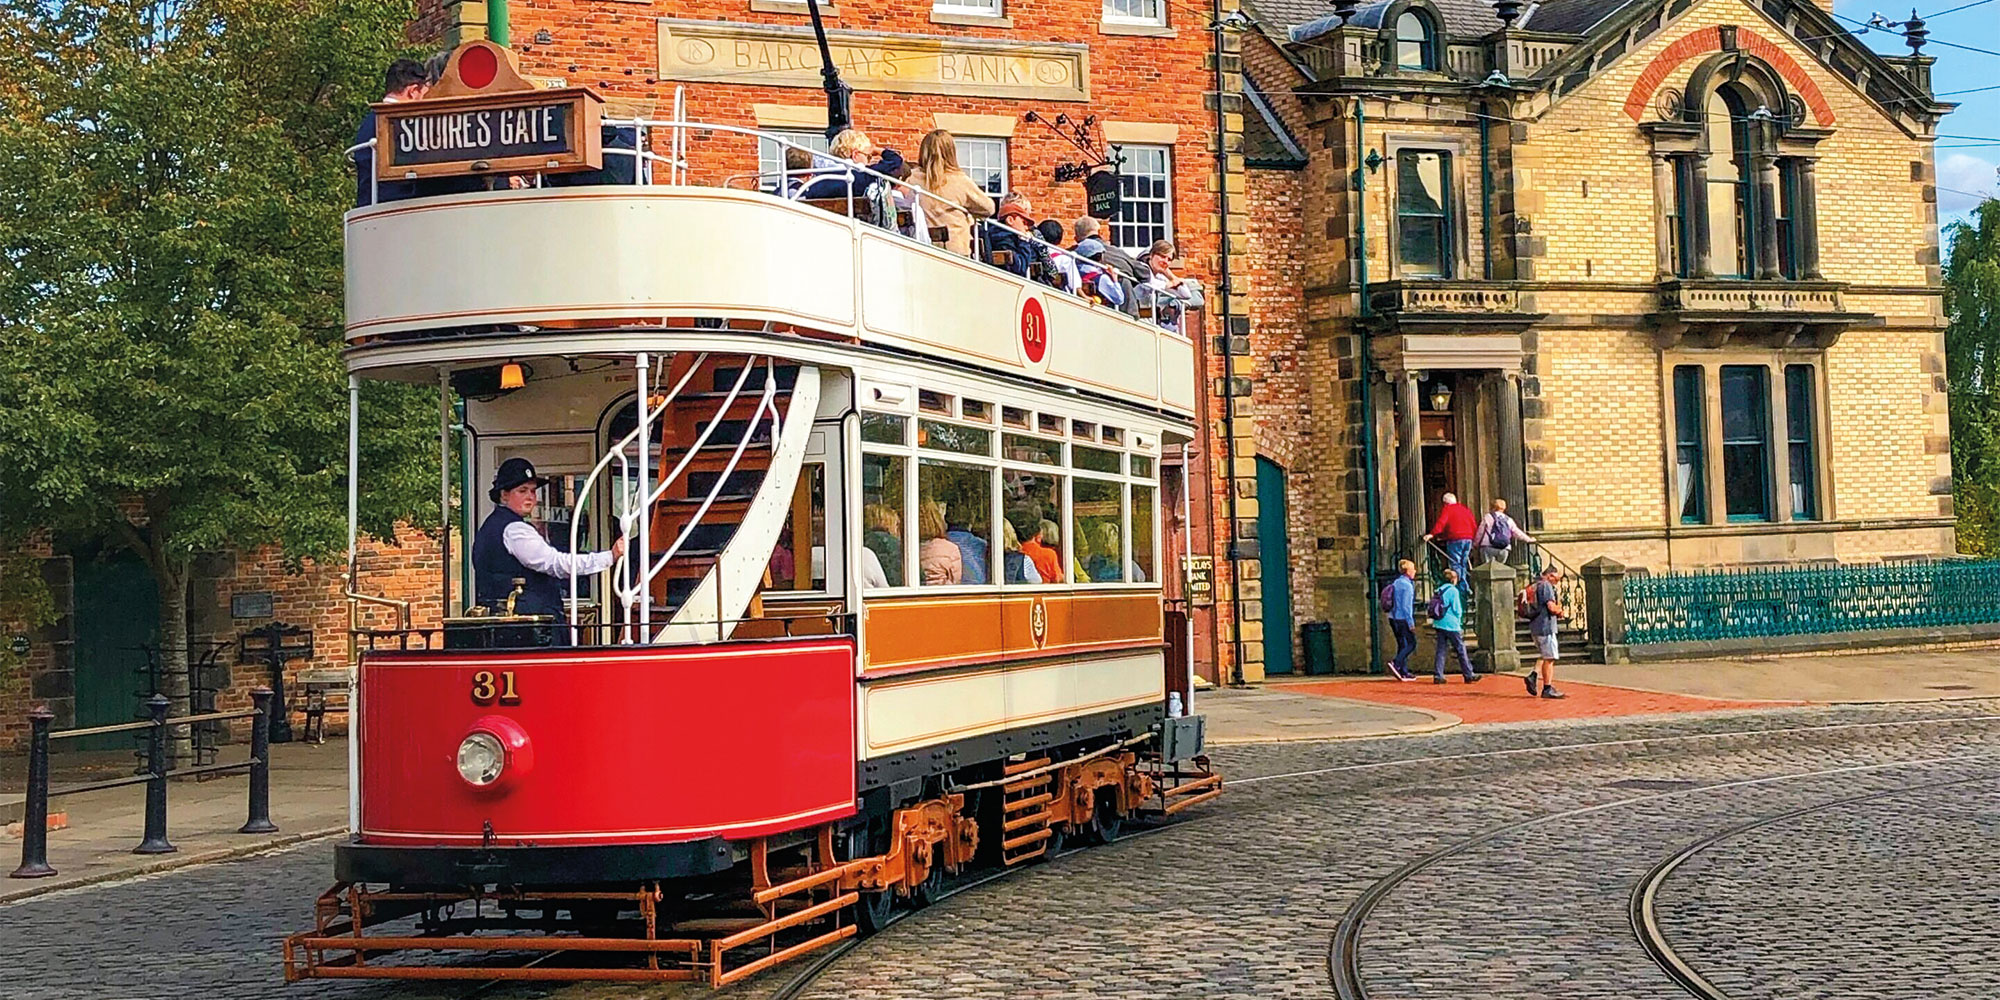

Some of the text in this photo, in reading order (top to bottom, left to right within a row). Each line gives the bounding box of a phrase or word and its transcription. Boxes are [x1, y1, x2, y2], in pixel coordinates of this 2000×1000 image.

[734, 40, 1020, 83] BARCAYS BANK
[400, 106, 558, 152] SQUIRES GATE
[1026, 312, 1042, 343] 31
[1184, 582, 1211, 592] LMITED
[1188, 572, 1207, 580] ANK
[472, 670, 520, 705] 31
